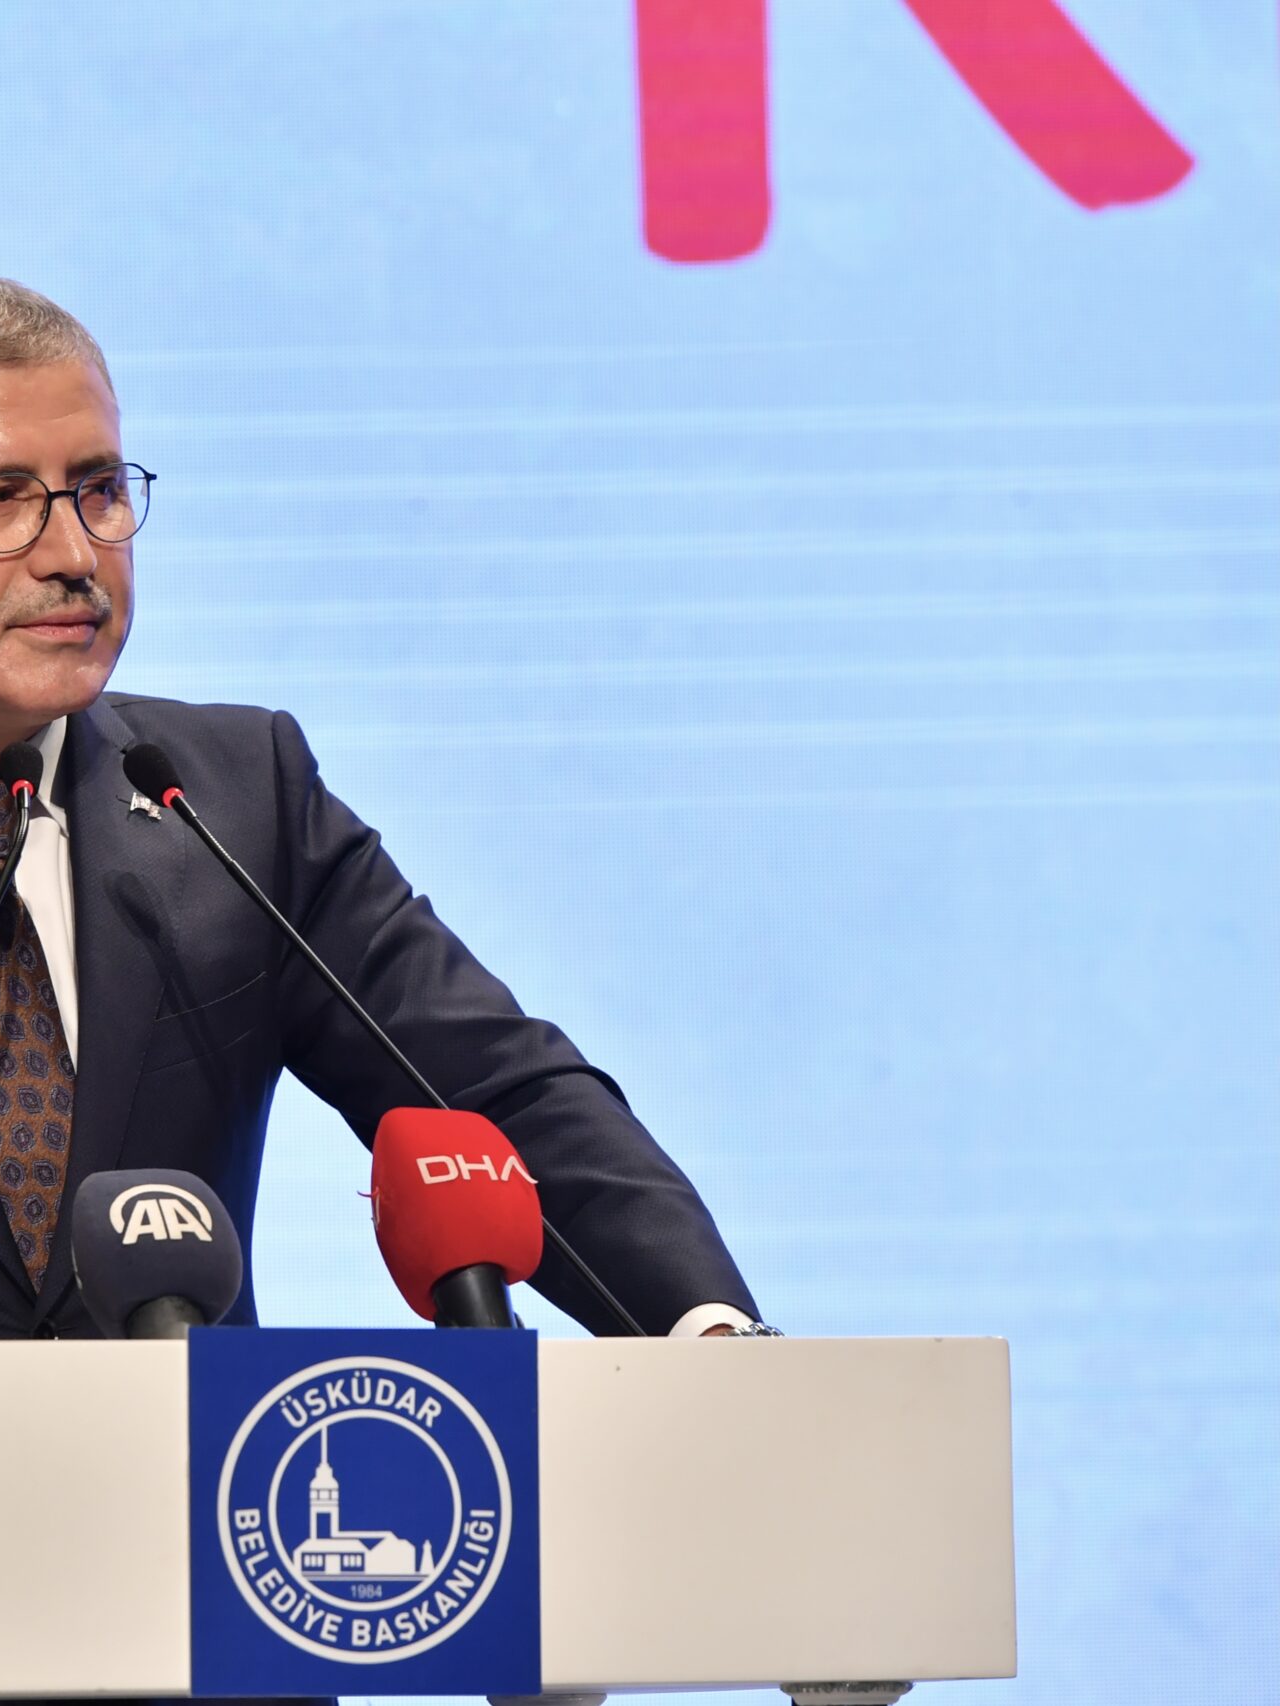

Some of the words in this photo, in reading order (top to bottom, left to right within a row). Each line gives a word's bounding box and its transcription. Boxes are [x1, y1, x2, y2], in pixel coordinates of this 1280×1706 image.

[416, 1153, 539, 1185] DHA
[122, 1198, 213, 1245] AA
[280, 1370, 442, 1429] ÜSKÜDAR
[234, 1507, 343, 1642] BELEDİYE
[351, 1508, 496, 1647] BAŞKANLIĞI
[350, 1584, 383, 1599] 1984
